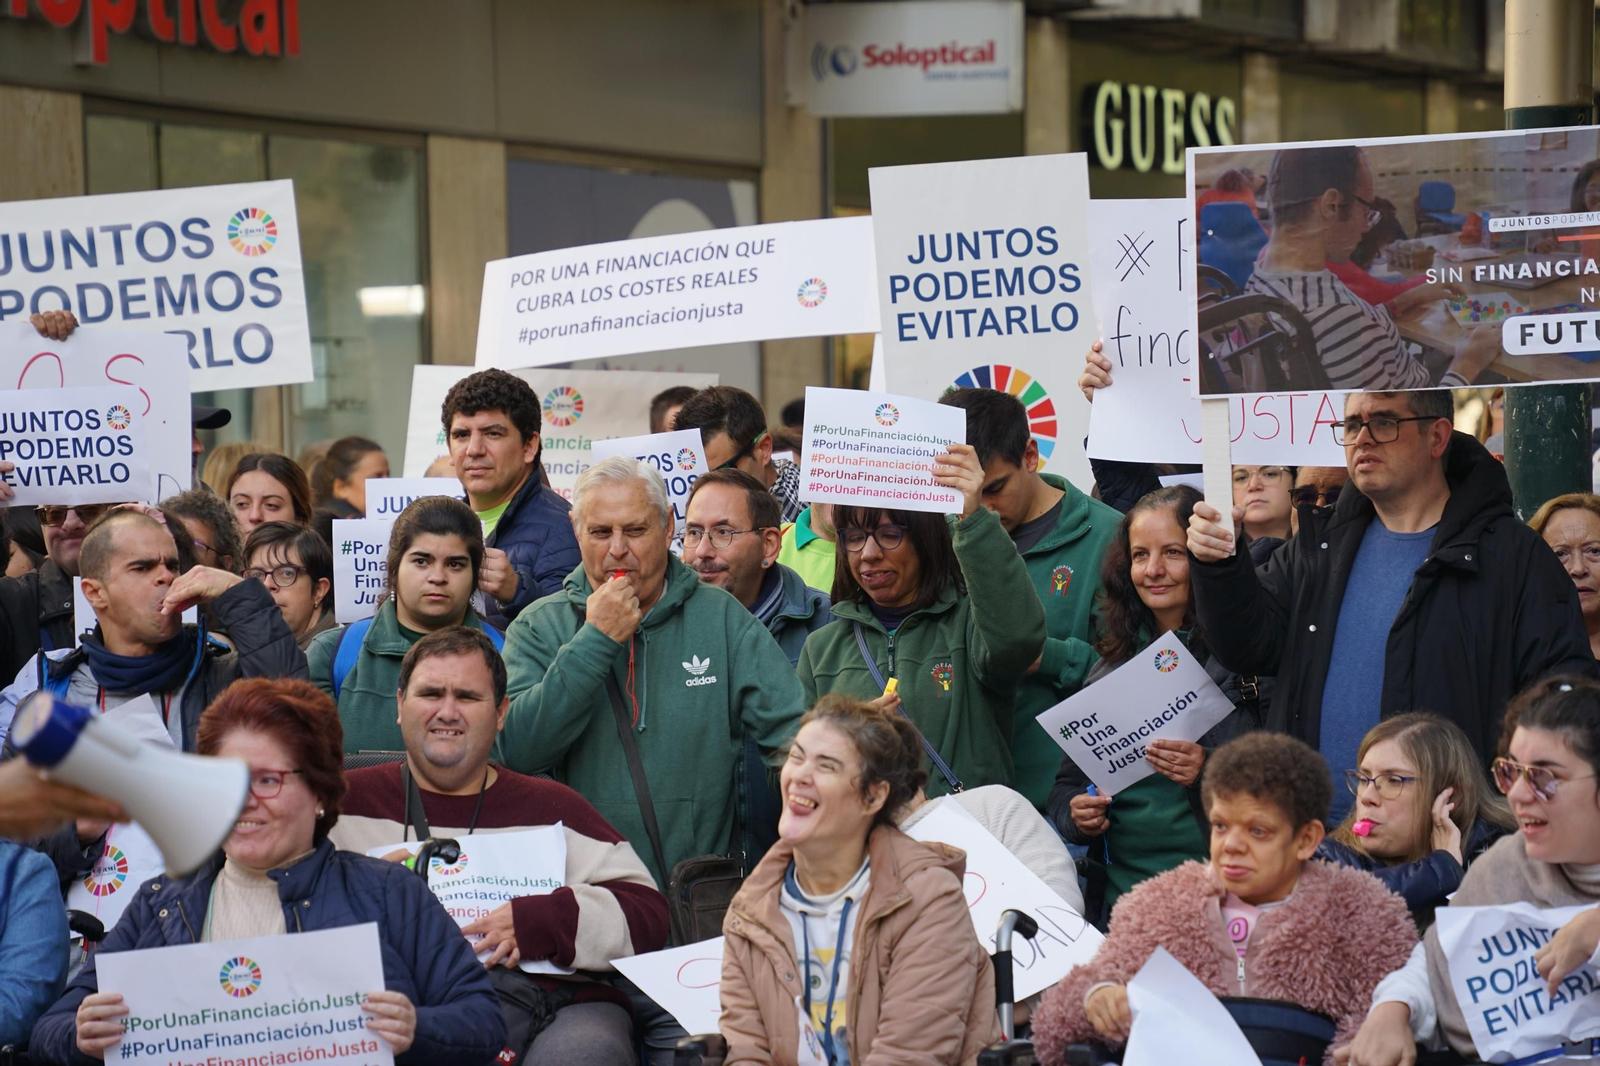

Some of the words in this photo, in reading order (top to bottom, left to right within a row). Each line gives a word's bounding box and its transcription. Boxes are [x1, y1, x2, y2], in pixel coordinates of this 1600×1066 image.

[862, 38, 996, 72] Soloptical
[1094, 80, 1236, 174] GUESS
[0, 216, 214, 276] JUNTOS
[510, 269, 545, 288] POR
[551, 262, 589, 281] UNA
[596, 240, 729, 275] FINANCIACIÓN
[735, 238, 776, 258] QUE
[907, 226, 1059, 264] JUNTOS
[516, 291, 575, 313] CUBRA
[581, 285, 613, 303] LOS
[619, 276, 686, 298] COSTES
[691, 268, 758, 290] REALES
[889, 263, 1082, 304] PODEMOS
[1426, 266, 1463, 284] SIN
[0, 266, 283, 327] PODEMOS
[518, 301, 744, 345] #porunafinanciacionjusta
[897, 302, 1079, 342] EVITARLO
[0, 409, 101, 434] JUNTOS
[0, 435, 134, 460] PODEMOS
[808, 482, 956, 503] #PorUnaFinanciaciónJusta
[341, 540, 382, 555] #Por
[685, 676, 717, 687] adidas
[1059, 711, 1100, 740] #Por
[1080, 723, 1118, 747] Una
[1092, 689, 1199, 761] Financiación
